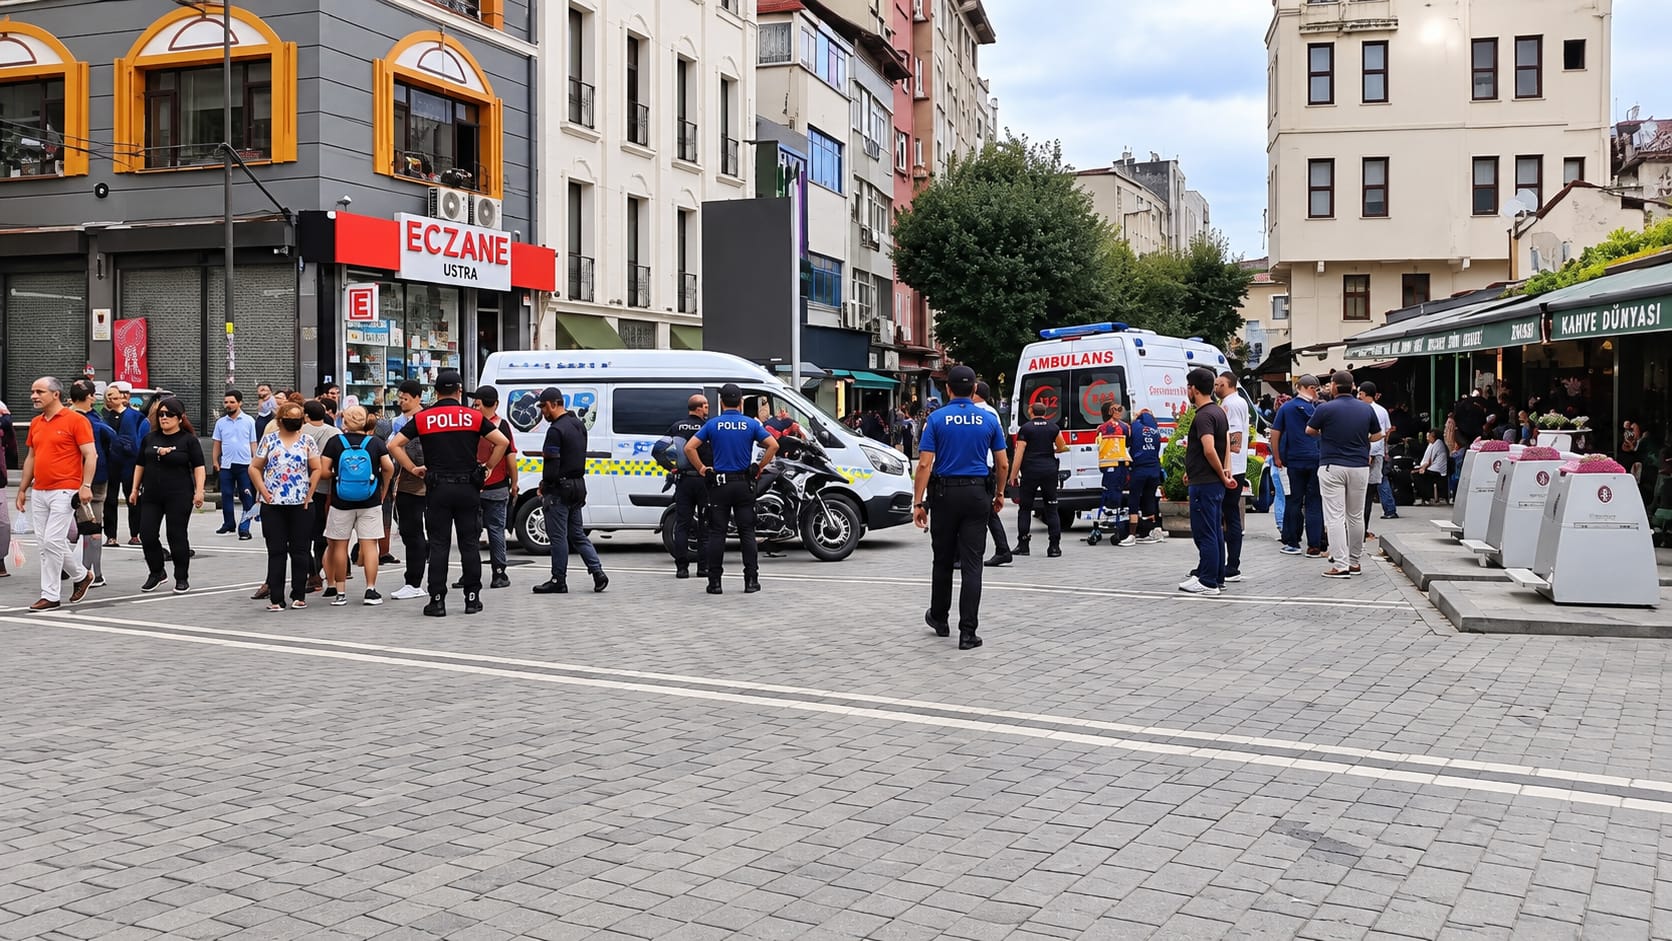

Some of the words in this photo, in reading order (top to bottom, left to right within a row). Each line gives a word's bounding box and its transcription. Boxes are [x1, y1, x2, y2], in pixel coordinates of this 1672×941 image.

[407, 220, 509, 266] ECZANE
[443, 263, 478, 281] USTRA
[354, 292, 369, 316] E
[1561, 312, 1597, 335] KAHVE
[1028, 351, 1114, 371] AMBULANS
[426, 409, 473, 430] POLİS
[945, 412, 983, 425] POLİS
